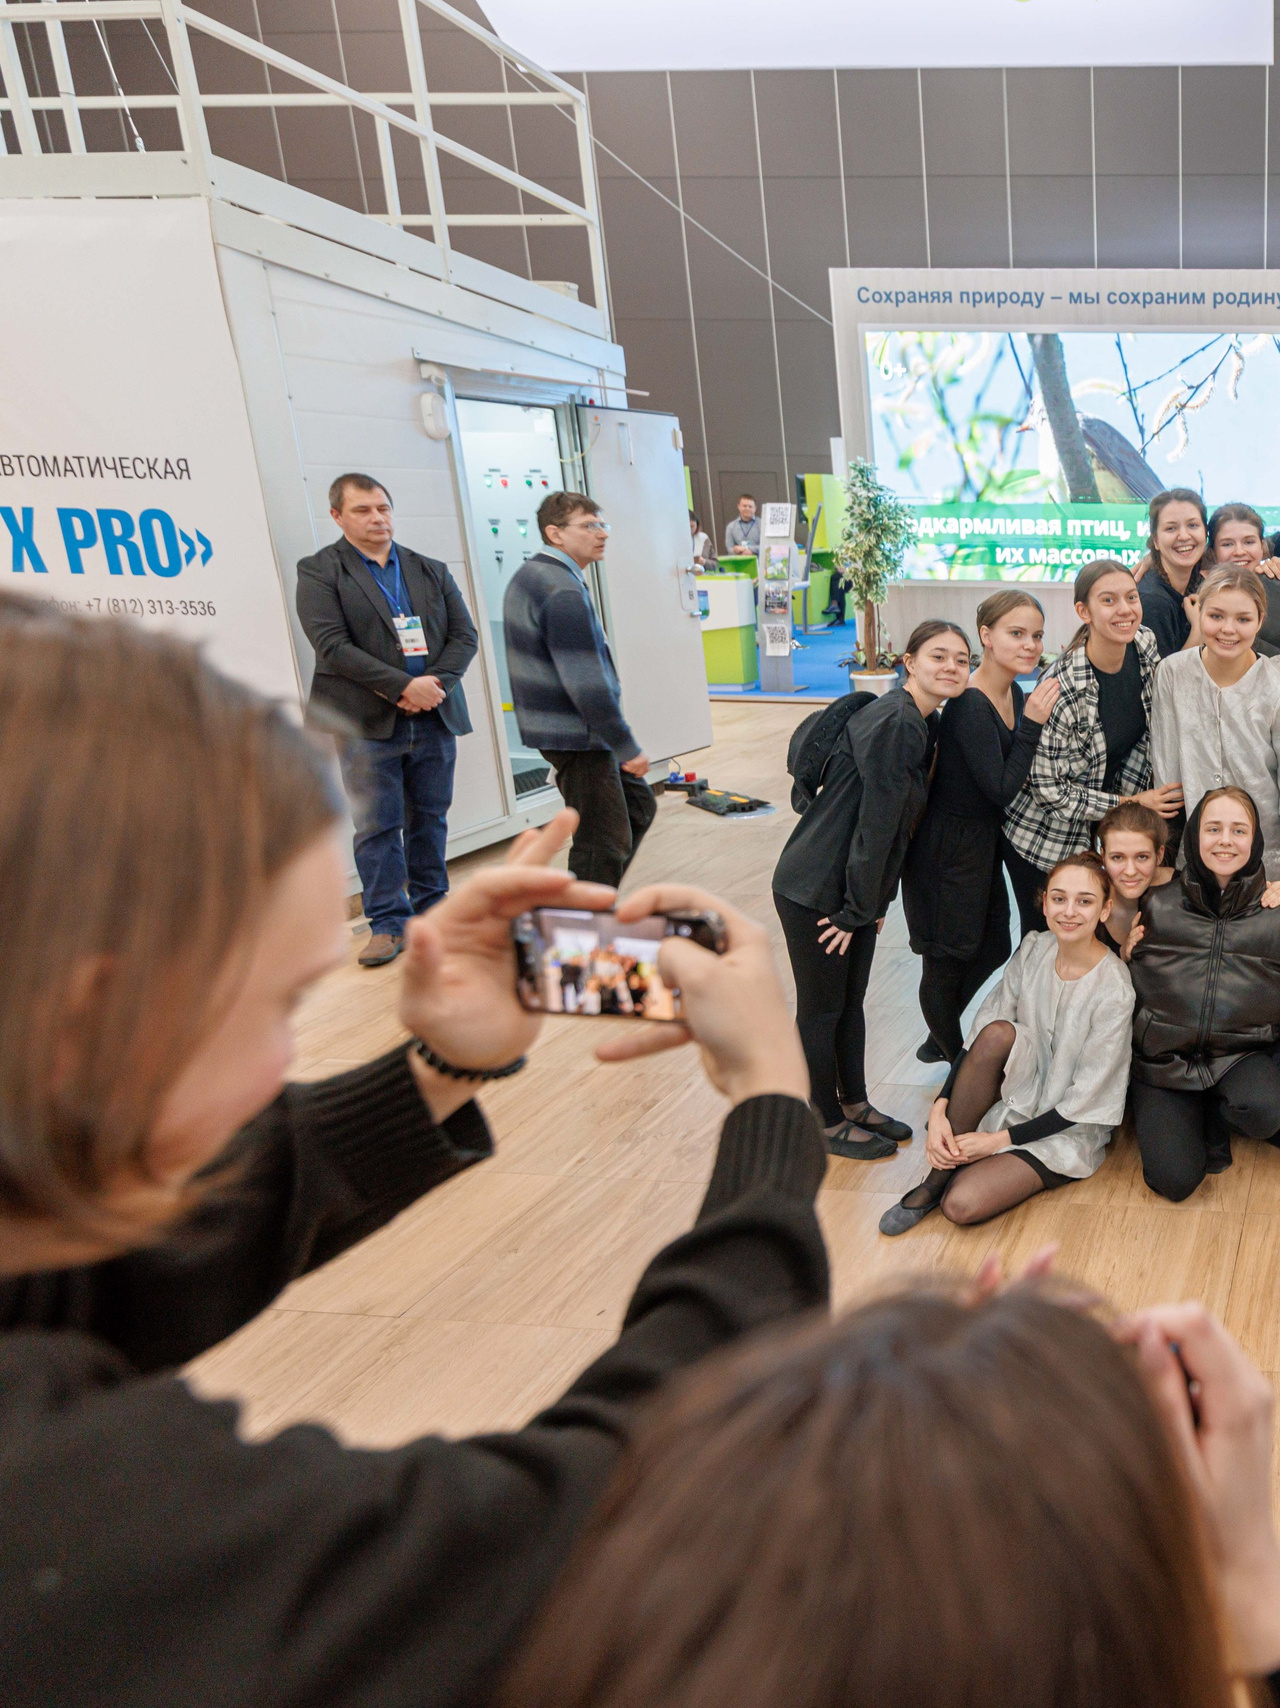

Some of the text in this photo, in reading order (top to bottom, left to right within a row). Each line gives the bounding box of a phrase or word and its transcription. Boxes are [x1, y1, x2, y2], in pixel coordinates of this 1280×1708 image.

[857, 286, 953, 308] Сохраняя
[959, 290, 1045, 309] природу
[1068, 291, 1100, 305] мы
[1106, 291, 1206, 309] сохраним
[0, 454, 192, 481] ВТОМАТИЧЕСКАЯ
[904, 516, 1061, 540] одкармливая
[1066, 518, 1132, 542] птиц,
[995, 546, 1142, 566] их массовых
[107, 597, 145, 618] (812)
[148, 599, 217, 617] 313-3536
